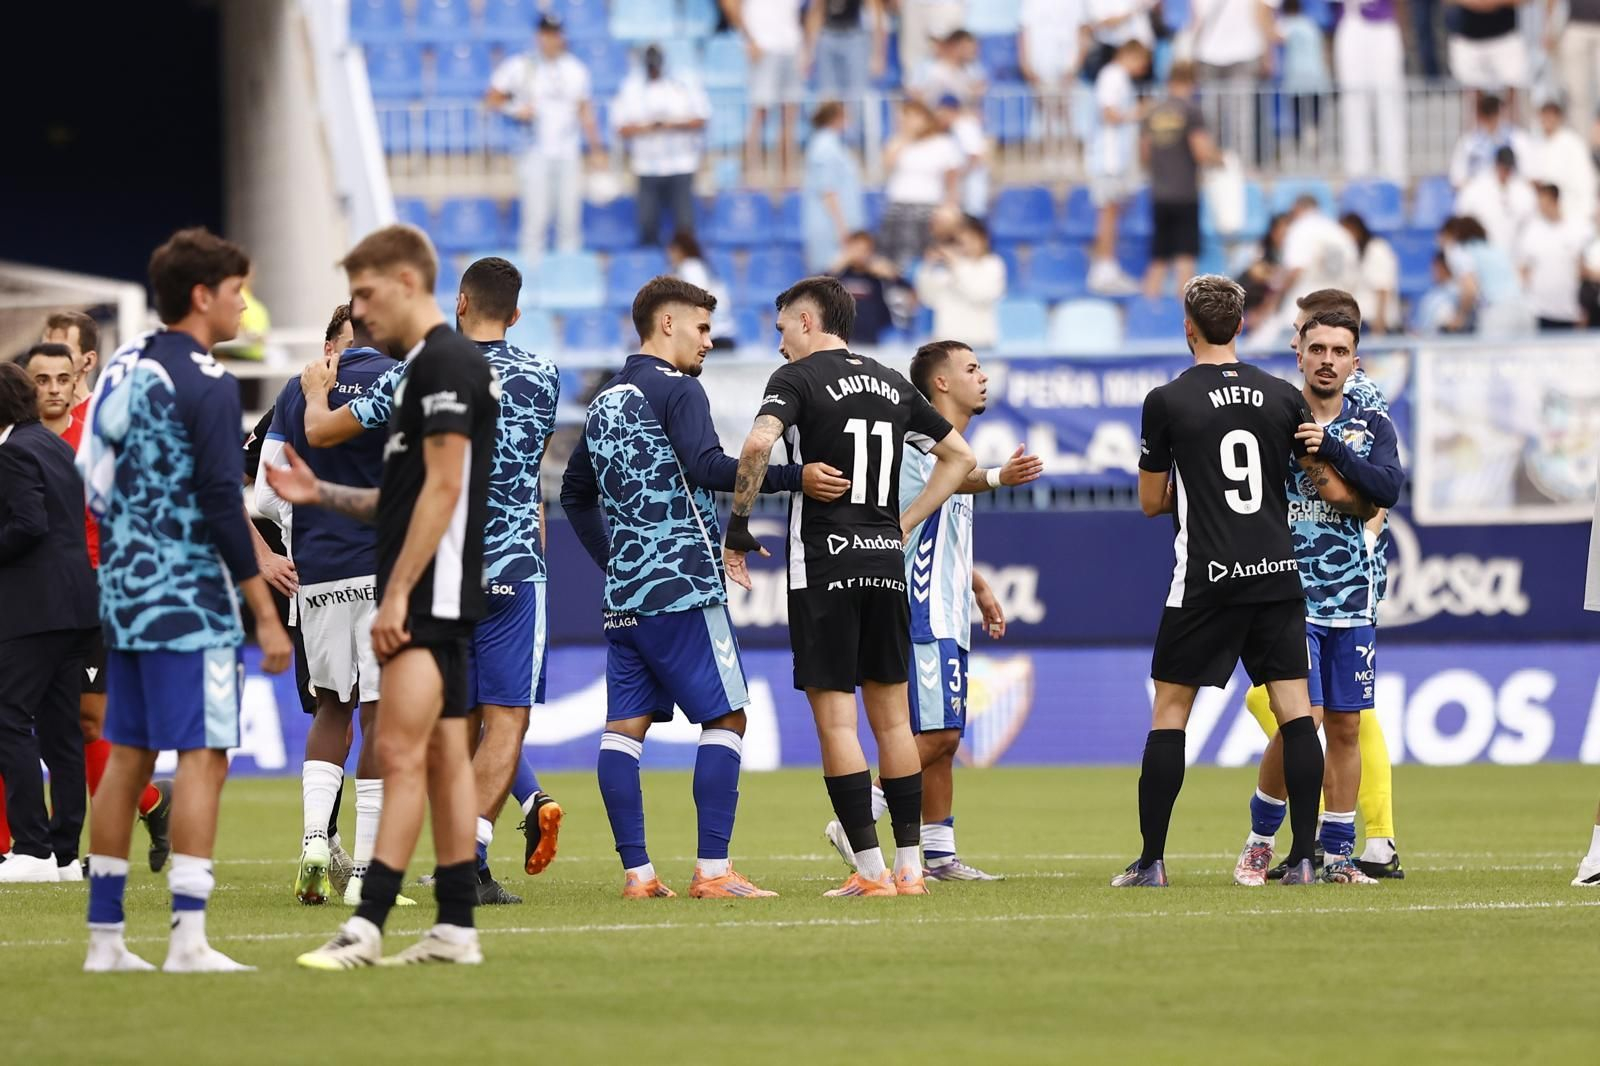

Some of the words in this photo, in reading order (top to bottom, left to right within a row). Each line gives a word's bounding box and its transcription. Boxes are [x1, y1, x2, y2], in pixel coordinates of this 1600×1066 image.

[825, 374, 901, 406] LAUTARO
[1207, 385, 1265, 409] NIETO
[843, 418, 894, 507] 11
[1219, 429, 1264, 515] 9
[1230, 556, 1299, 579] Andorra
[491, 584, 516, 596] SOL
[947, 657, 962, 693] 3
